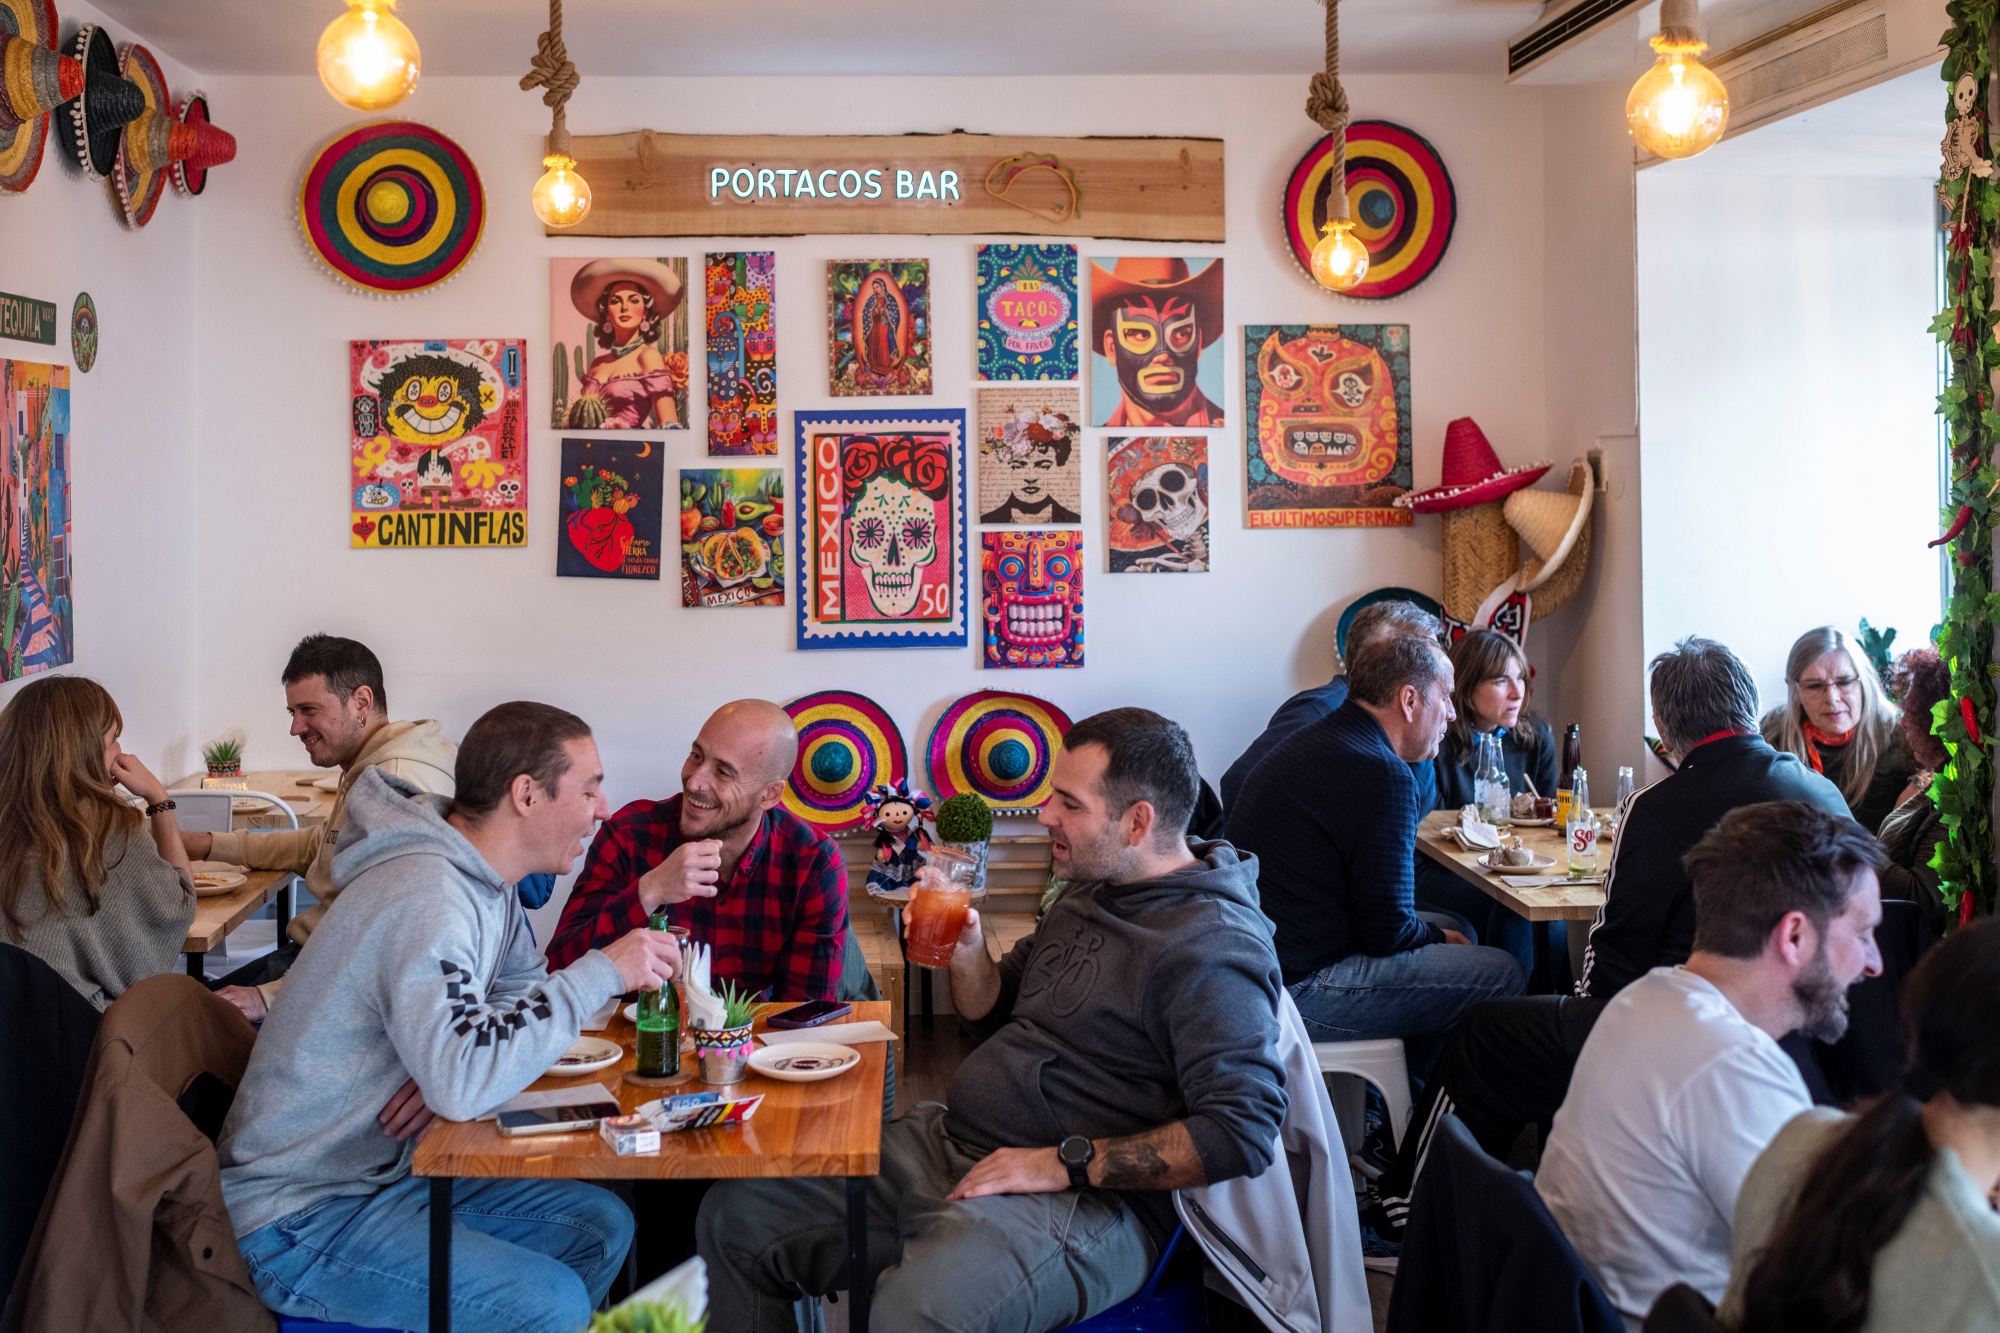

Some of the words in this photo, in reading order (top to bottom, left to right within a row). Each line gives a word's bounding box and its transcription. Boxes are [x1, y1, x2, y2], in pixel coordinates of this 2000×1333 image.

[711, 168, 882, 198] PORTACOS
[896, 170, 960, 200] BAR
[0, 297, 41, 340] TEQUILA
[42, 306, 55, 323] WAY
[1001, 300, 1058, 318] TACOS
[1008, 338, 1022, 350] POR
[1026, 339, 1051, 351] FAVOR
[378, 511, 524, 546] CANTINFLAS
[818, 437, 841, 617] MEXICO
[621, 565, 656, 575] FLOREZCO
[922, 583, 949, 616] 50
